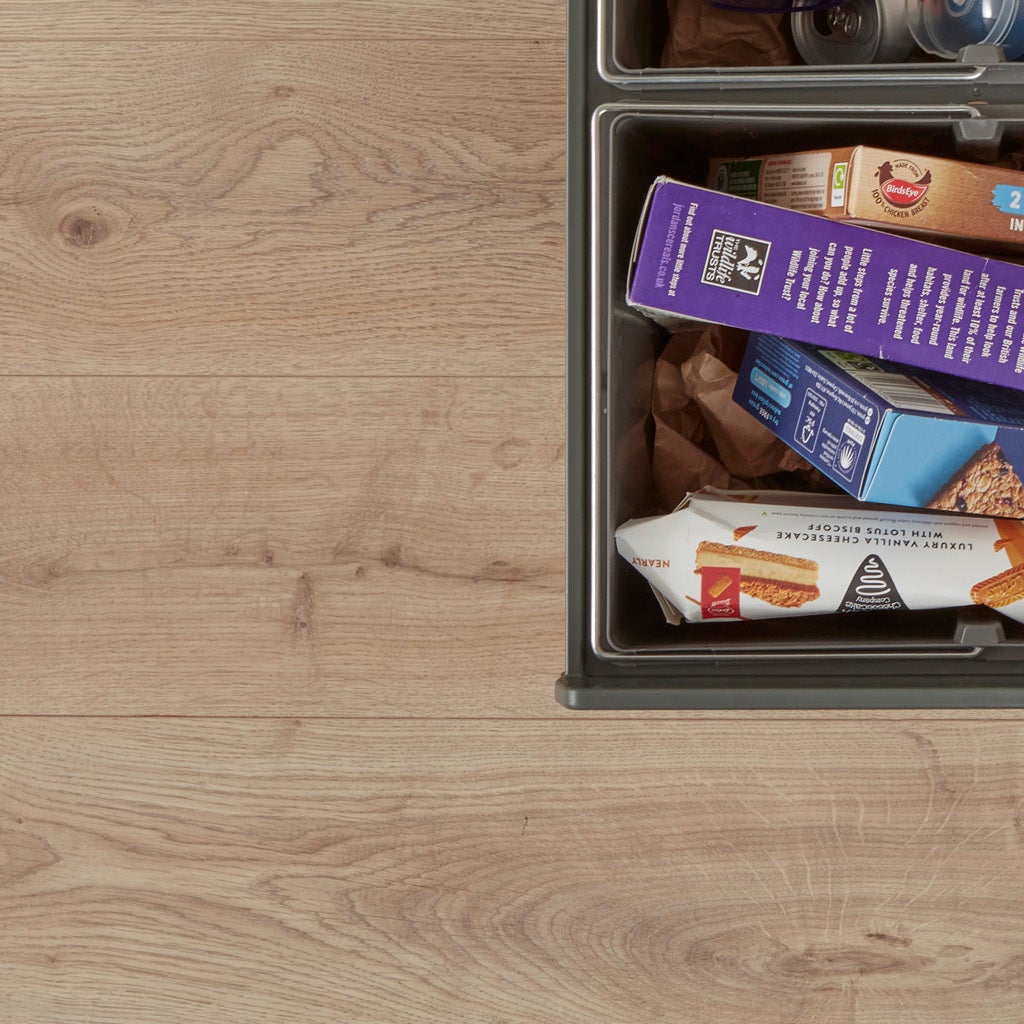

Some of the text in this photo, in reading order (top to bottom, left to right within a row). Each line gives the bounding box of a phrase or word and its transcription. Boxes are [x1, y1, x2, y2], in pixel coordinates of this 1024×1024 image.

[871, 189, 930, 218] 100% CHICKEN BREAST
[1009, 190, 1021, 209] 2
[687, 202, 698, 216] Find
[684, 215, 693, 226] out
[1010, 218, 1024, 231] IN
[680, 226, 691, 243] about
[654, 202, 684, 288] jordanscereals.co.uk
[676, 243, 686, 258] more
[733, 239, 741, 251] THE
[673, 258, 684, 272] little
[706, 235, 724, 281] TRUSTS
[716, 237, 737, 284] wildlife
[840, 245, 853, 270] people
[859, 248, 872, 266] Little
[668, 273, 679, 289] steps
[781, 250, 802, 301] Wildlife Trust?
[796, 247, 820, 310] joining your local
[810, 242, 836, 323] can you do? How about
[837, 270, 847, 285] add
[853, 267, 866, 287] steps
[978, 272, 989, 289] after
[832, 286, 843, 297] up,
[849, 288, 862, 306] from
[877, 268, 897, 325] species survive.
[991, 285, 1006, 314] farmers
[892, 263, 917, 339] and helps threatened
[910, 266, 937, 344] habitats, shelter, food
[928, 273, 951, 345] provides year-round
[971, 298, 984, 317] least
[826, 309, 839, 327] what
[845, 313, 856, 324] lot
[943, 269, 973, 359] land for wildlife. This land
[967, 319, 980, 335] 10%
[983, 323, 997, 340] help
[998, 288, 1024, 363] Trusts and our British
[961, 345, 973, 364] their
[980, 340, 993, 357] look
[807, 523, 942, 538] WITH LOTUS BISCOFF
[776, 531, 972, 550] LUXURY VANILLA CHEESECAKE
[631, 557, 670, 568] NEARLY
[856, 595, 890, 603] Company
